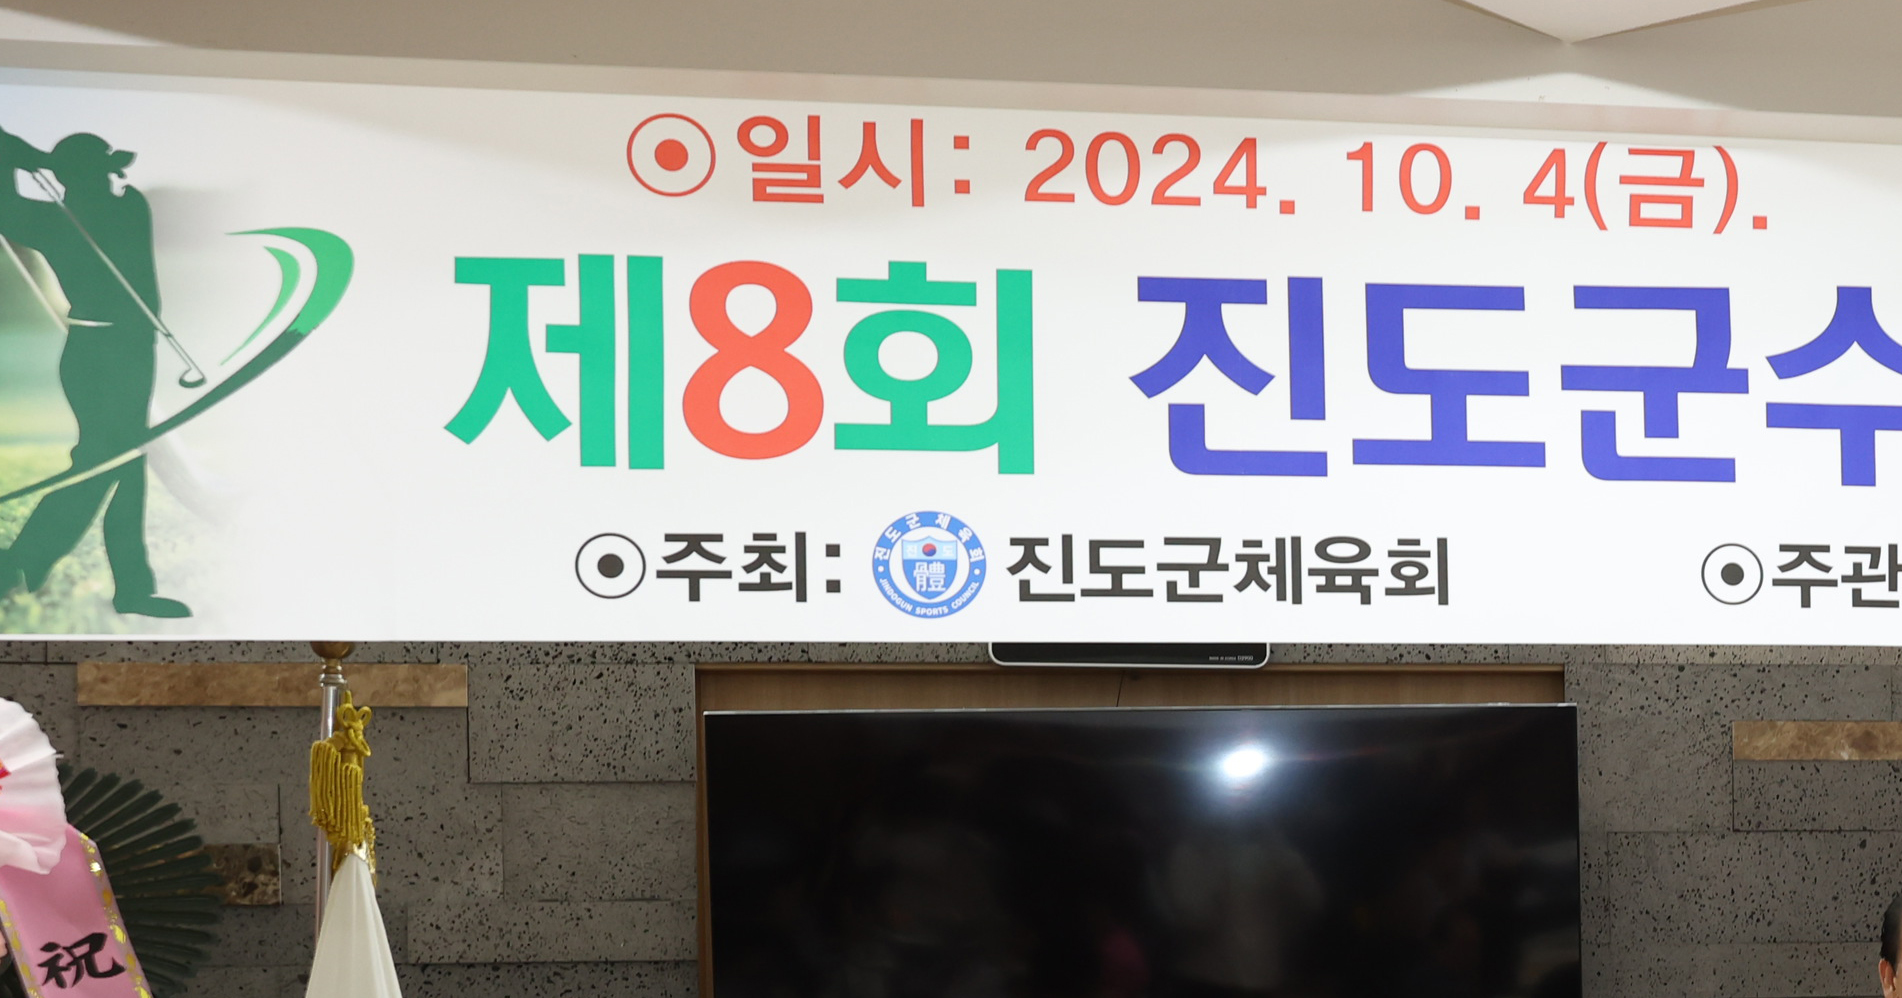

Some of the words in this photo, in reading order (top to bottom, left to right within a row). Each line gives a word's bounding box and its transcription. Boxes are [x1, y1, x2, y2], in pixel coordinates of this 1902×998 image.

[737, 114, 971, 208] 일시:
[1024, 128, 1296, 215] 2024.
[1346, 140, 1481, 220] 10.
[1523, 141, 1768, 235] 4(금).
[443, 253, 1035, 475] 제8회
[655, 531, 842, 603] 주최:
[879, 577, 914, 612] JINDOGUN
[915, 604, 950, 616] SPORTS
[951, 580, 980, 610] COUNCIL
[1007, 531, 1451, 606] 진도군체육회
[37, 932, 126, 990] 祝
